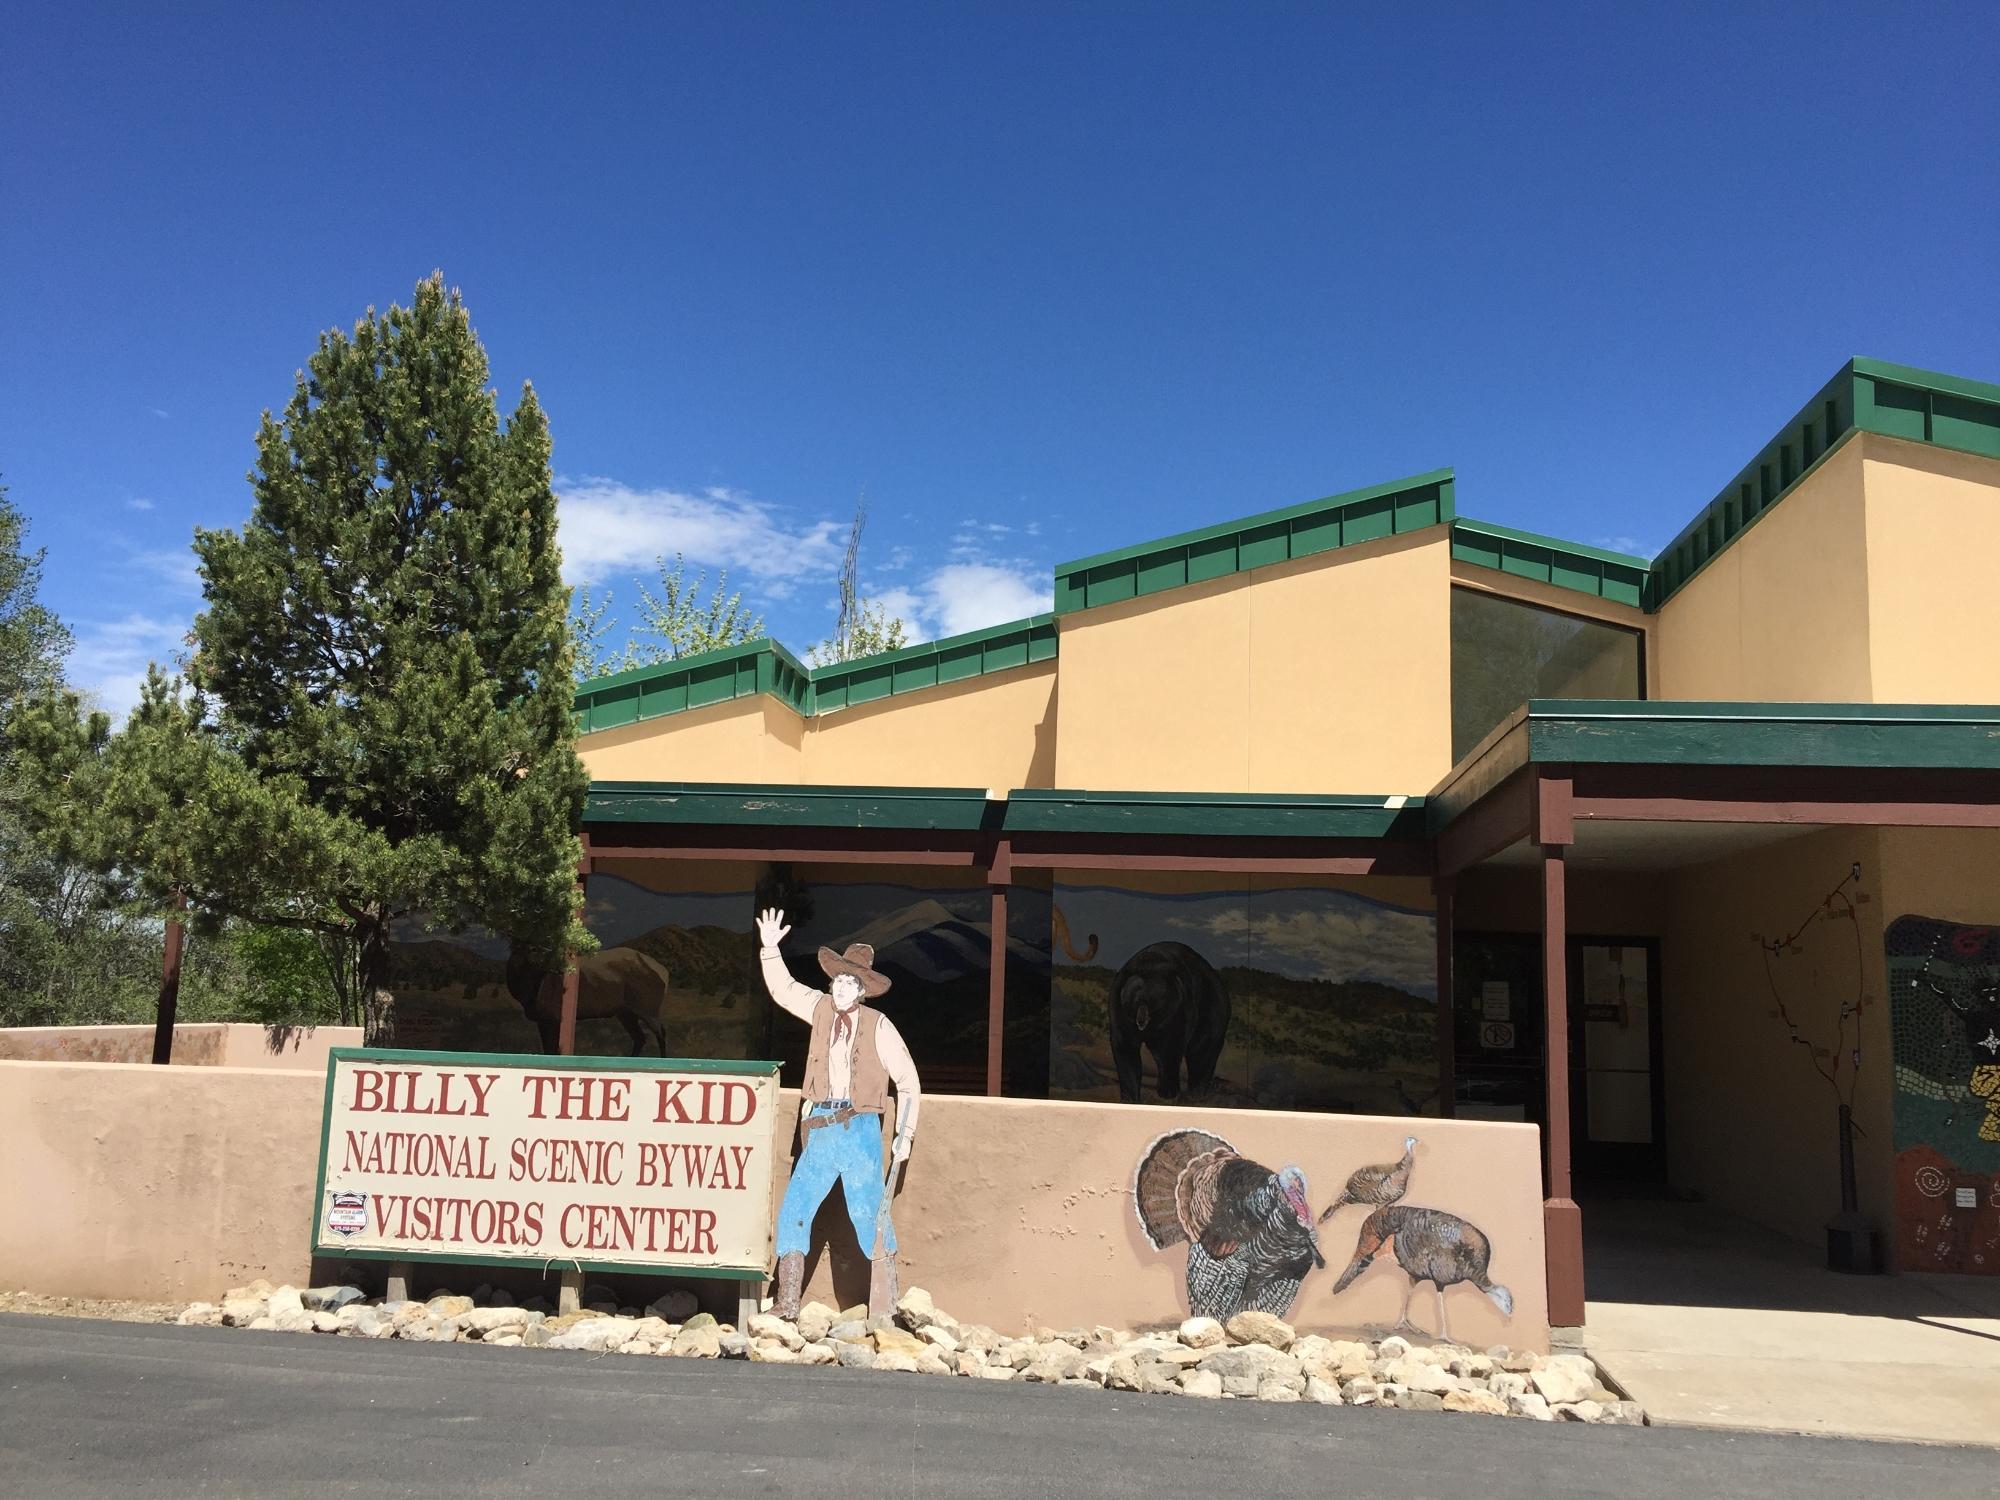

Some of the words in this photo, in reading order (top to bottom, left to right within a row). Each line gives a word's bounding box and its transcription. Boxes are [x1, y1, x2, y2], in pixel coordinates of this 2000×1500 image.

[349, 1069, 500, 1117] BILLY
[522, 1075, 632, 1121] THE
[652, 1079, 758, 1126] KID
[342, 1130, 497, 1180] NATIONAL
[508, 1137, 625, 1186] SCENIC
[636, 1142, 754, 1190] BYWAY
[371, 1194, 544, 1247] VISITORS
[559, 1203, 719, 1255] CENTER
